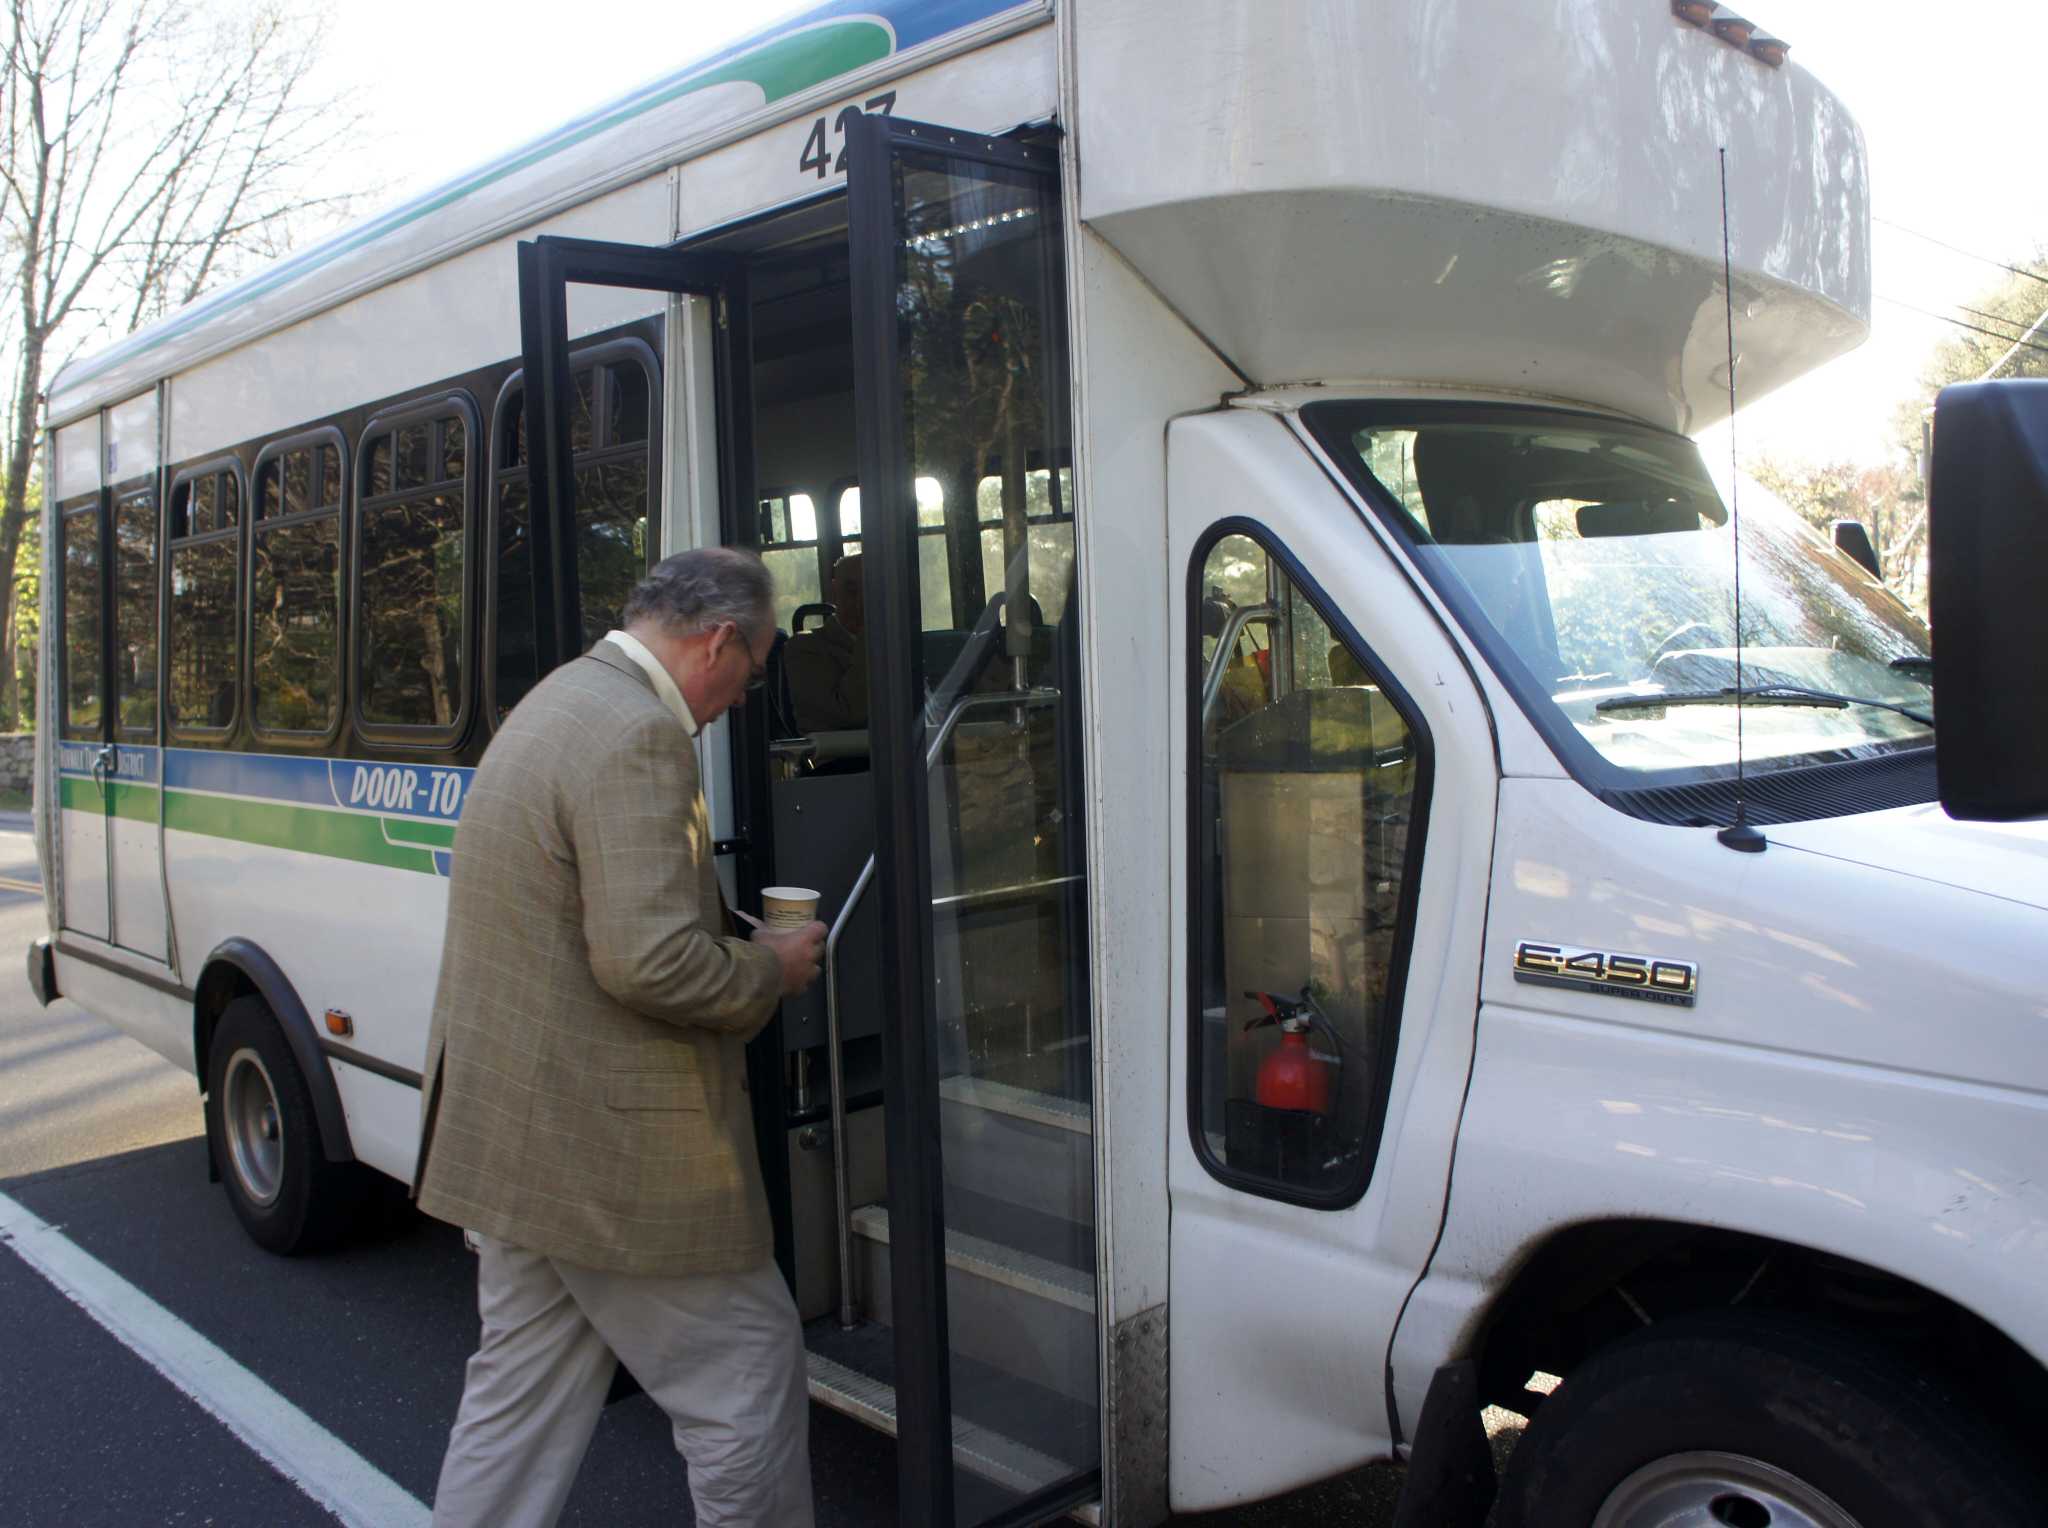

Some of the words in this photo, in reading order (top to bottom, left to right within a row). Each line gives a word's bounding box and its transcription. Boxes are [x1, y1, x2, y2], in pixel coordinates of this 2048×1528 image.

[1517, 943, 1692, 990] E-450
[1589, 983, 1641, 998] SUPER
[1647, 991, 1687, 1004] DUTY
